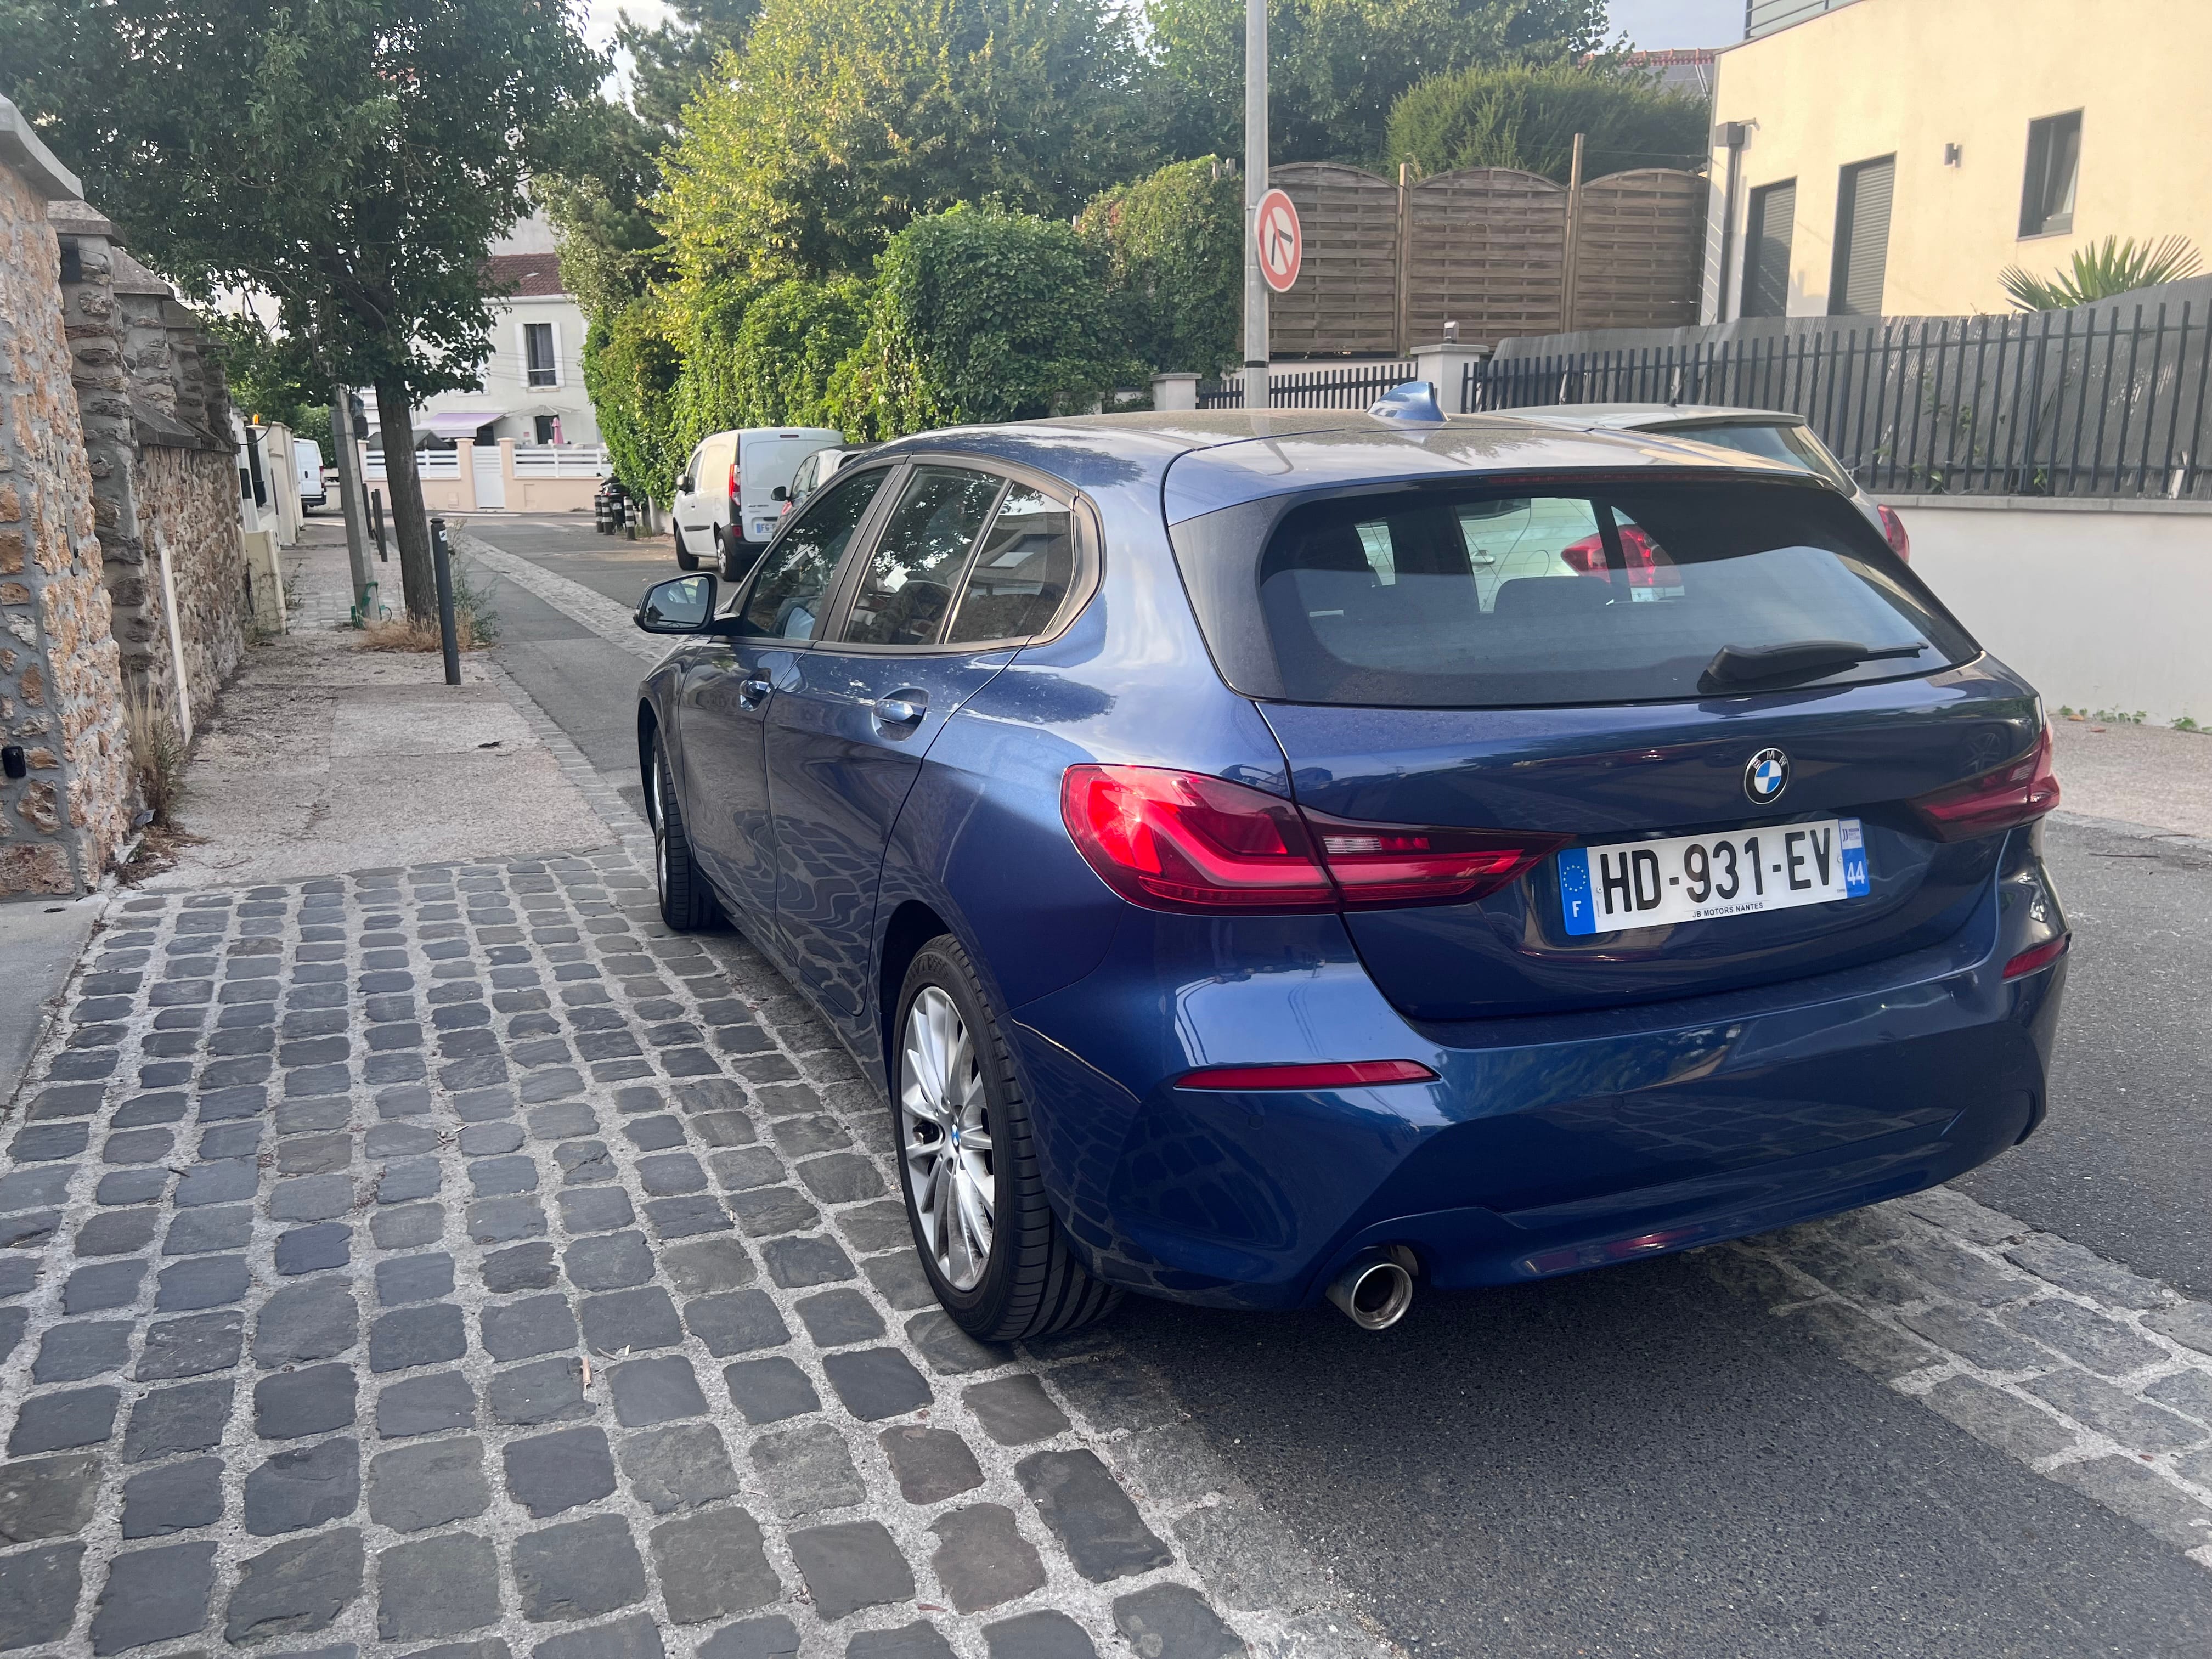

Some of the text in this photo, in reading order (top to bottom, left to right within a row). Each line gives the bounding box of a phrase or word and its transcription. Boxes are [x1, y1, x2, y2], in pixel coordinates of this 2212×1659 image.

[1752, 751, 1787, 769] BMW
[1600, 828, 1830, 915] HD-931-EV
[1847, 861, 1865, 885] 44
[1572, 900, 1581, 917] F
[1704, 907, 1734, 916] MOTORS
[1736, 902, 1763, 912] NANTES
